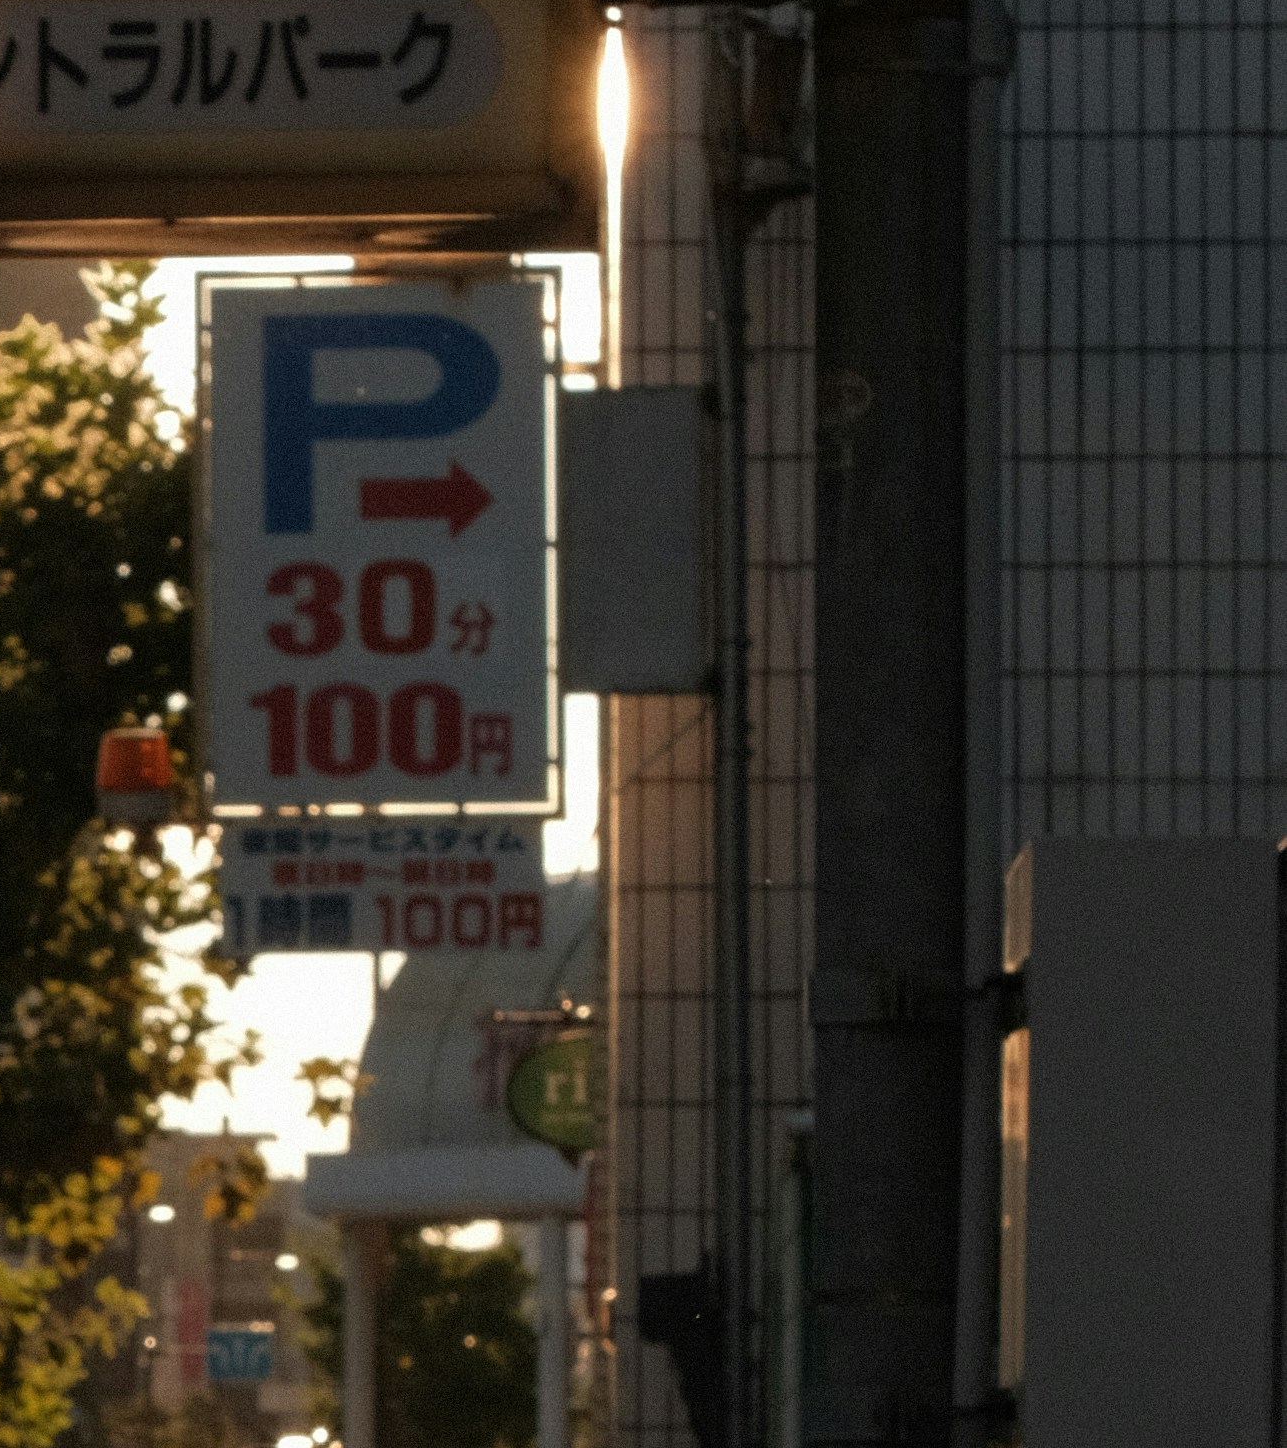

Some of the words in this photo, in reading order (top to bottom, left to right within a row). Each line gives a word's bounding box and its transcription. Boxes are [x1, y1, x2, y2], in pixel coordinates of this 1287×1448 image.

[262, 312, 502, 536] P
[264, 559, 497, 659] 30分
[248, 681, 513, 780] 100円
